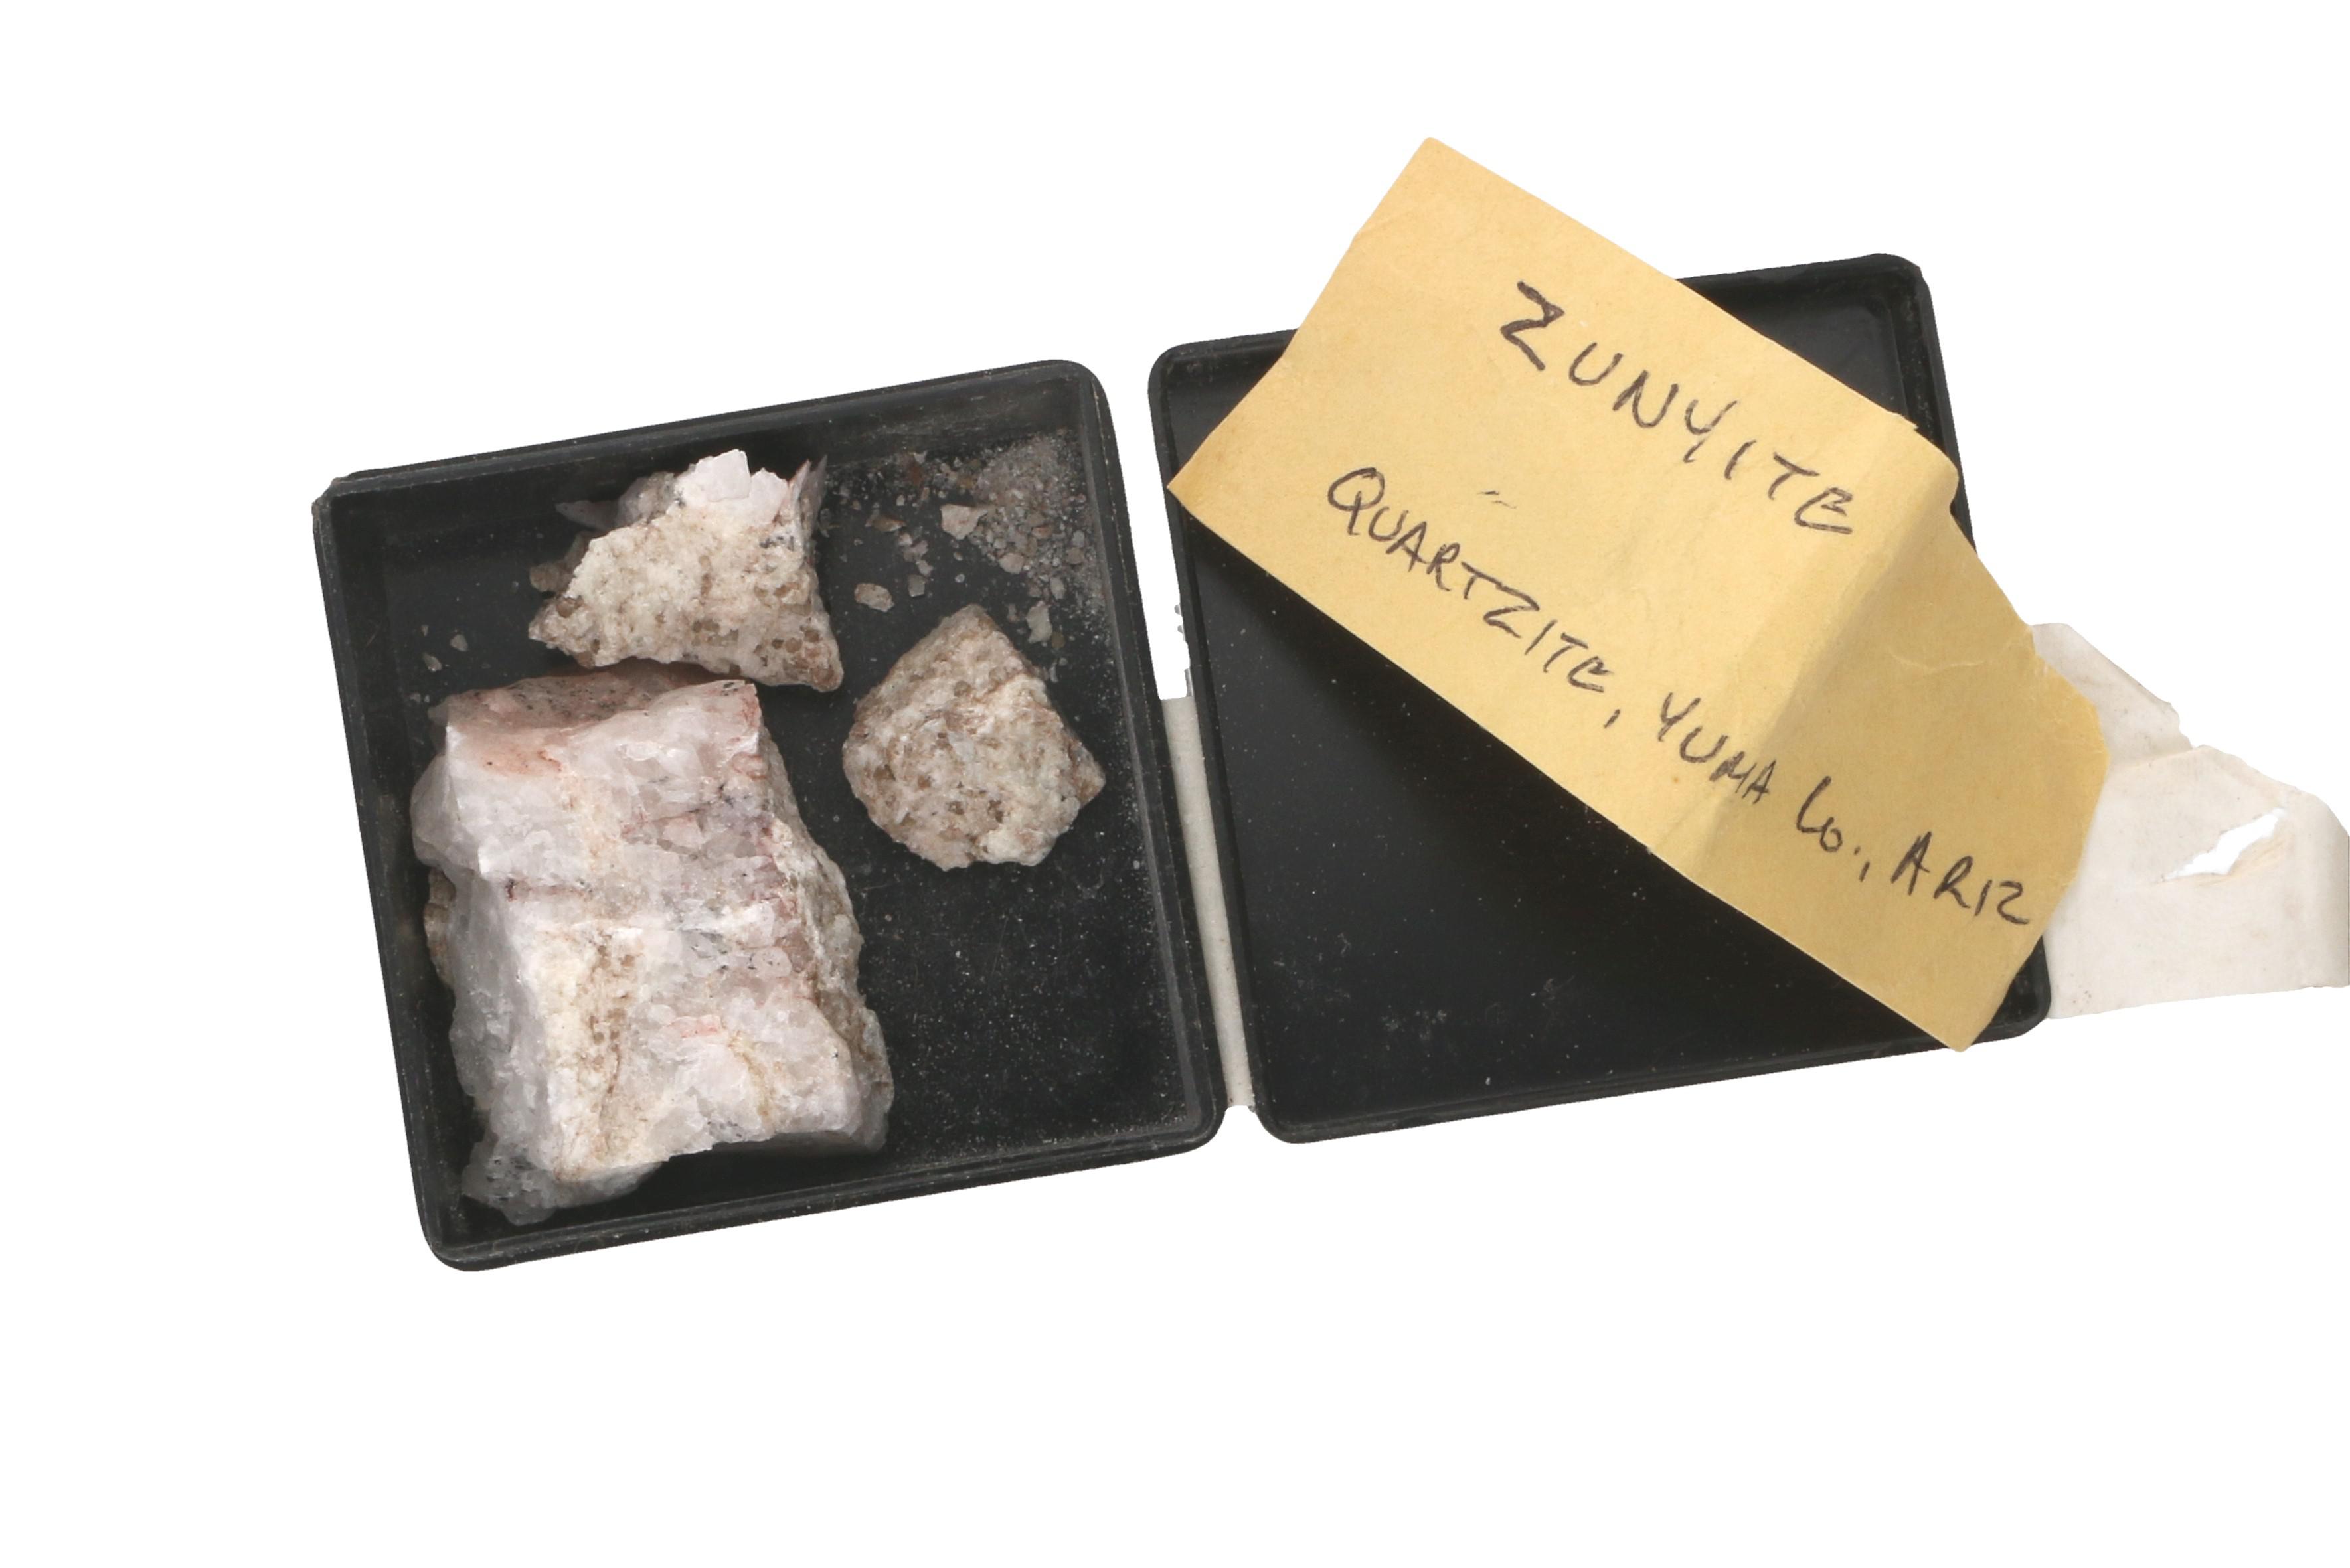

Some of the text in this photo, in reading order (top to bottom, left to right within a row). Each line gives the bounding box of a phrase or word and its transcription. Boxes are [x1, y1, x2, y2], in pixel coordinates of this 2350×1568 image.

[1500, 280, 1854, 535] ZUNYITE
[1660, 690, 1777, 805] YUMA
[1890, 830, 2030, 925] ARIZ
